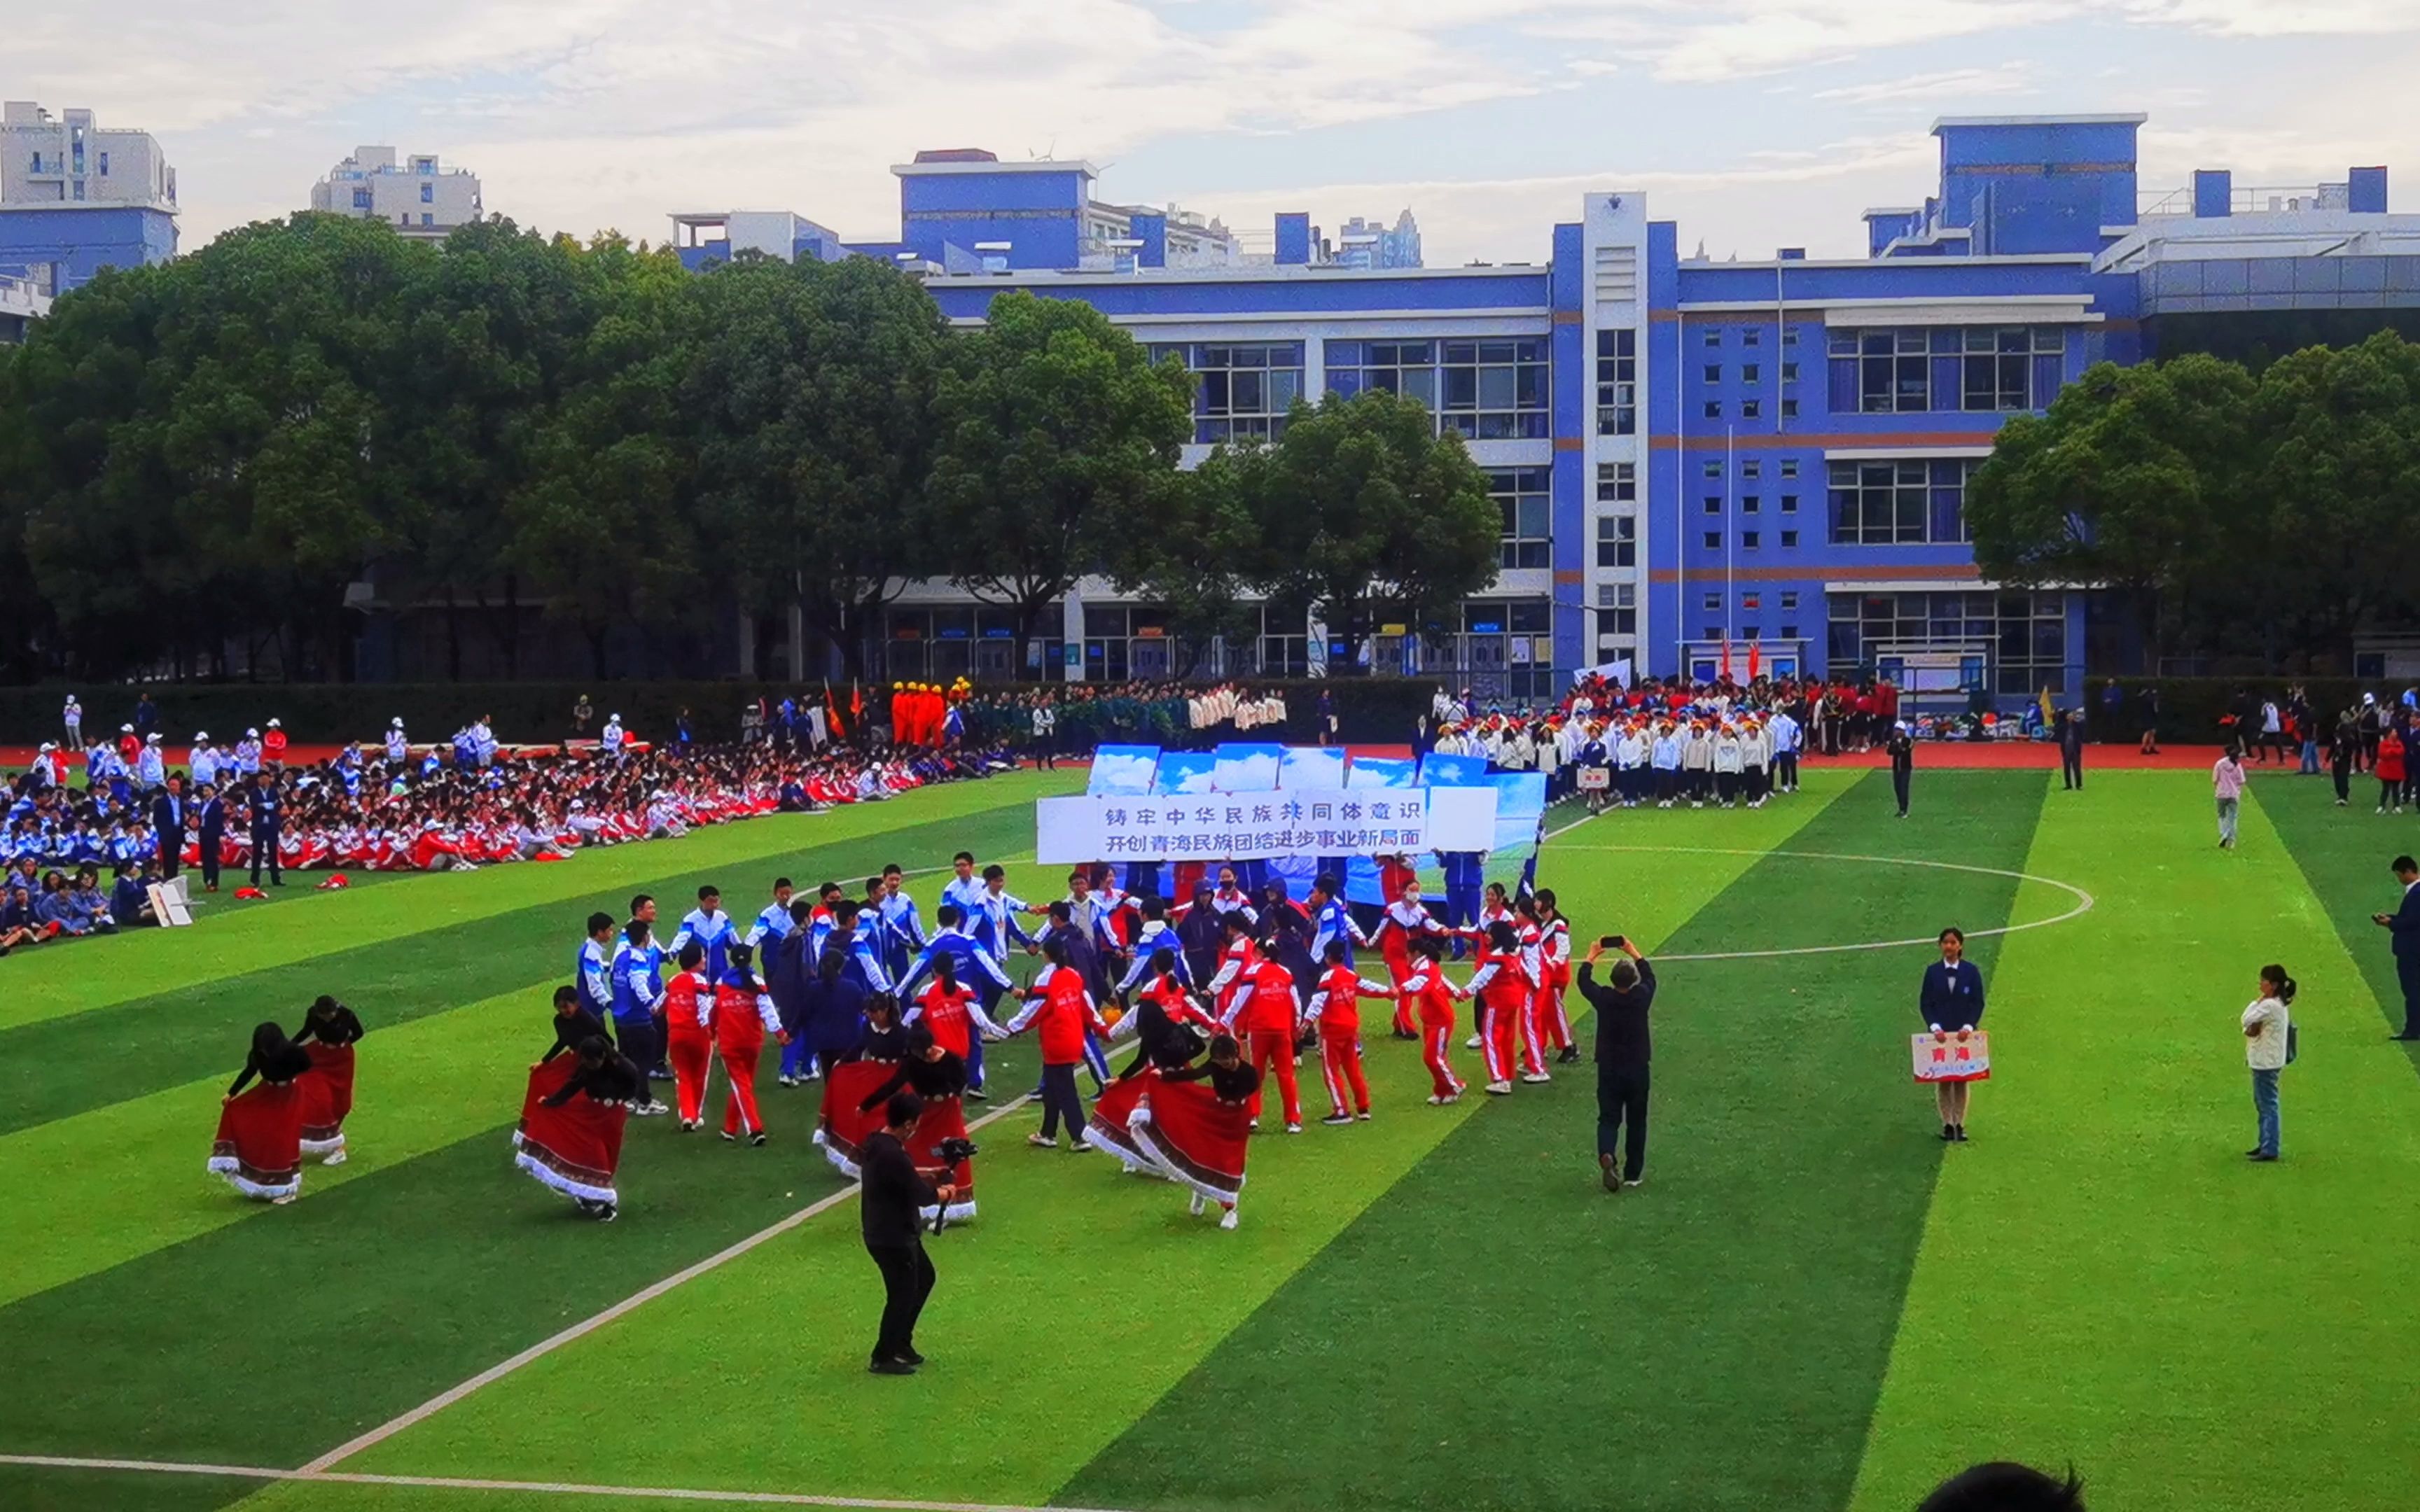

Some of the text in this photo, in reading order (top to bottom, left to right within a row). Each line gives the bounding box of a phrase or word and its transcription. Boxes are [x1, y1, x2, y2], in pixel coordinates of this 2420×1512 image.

[1106, 802, 1420, 826] 铸牢中华民族共同体意识
[1106, 830, 1421, 853] 开创青海民族团结进步事业新局面
